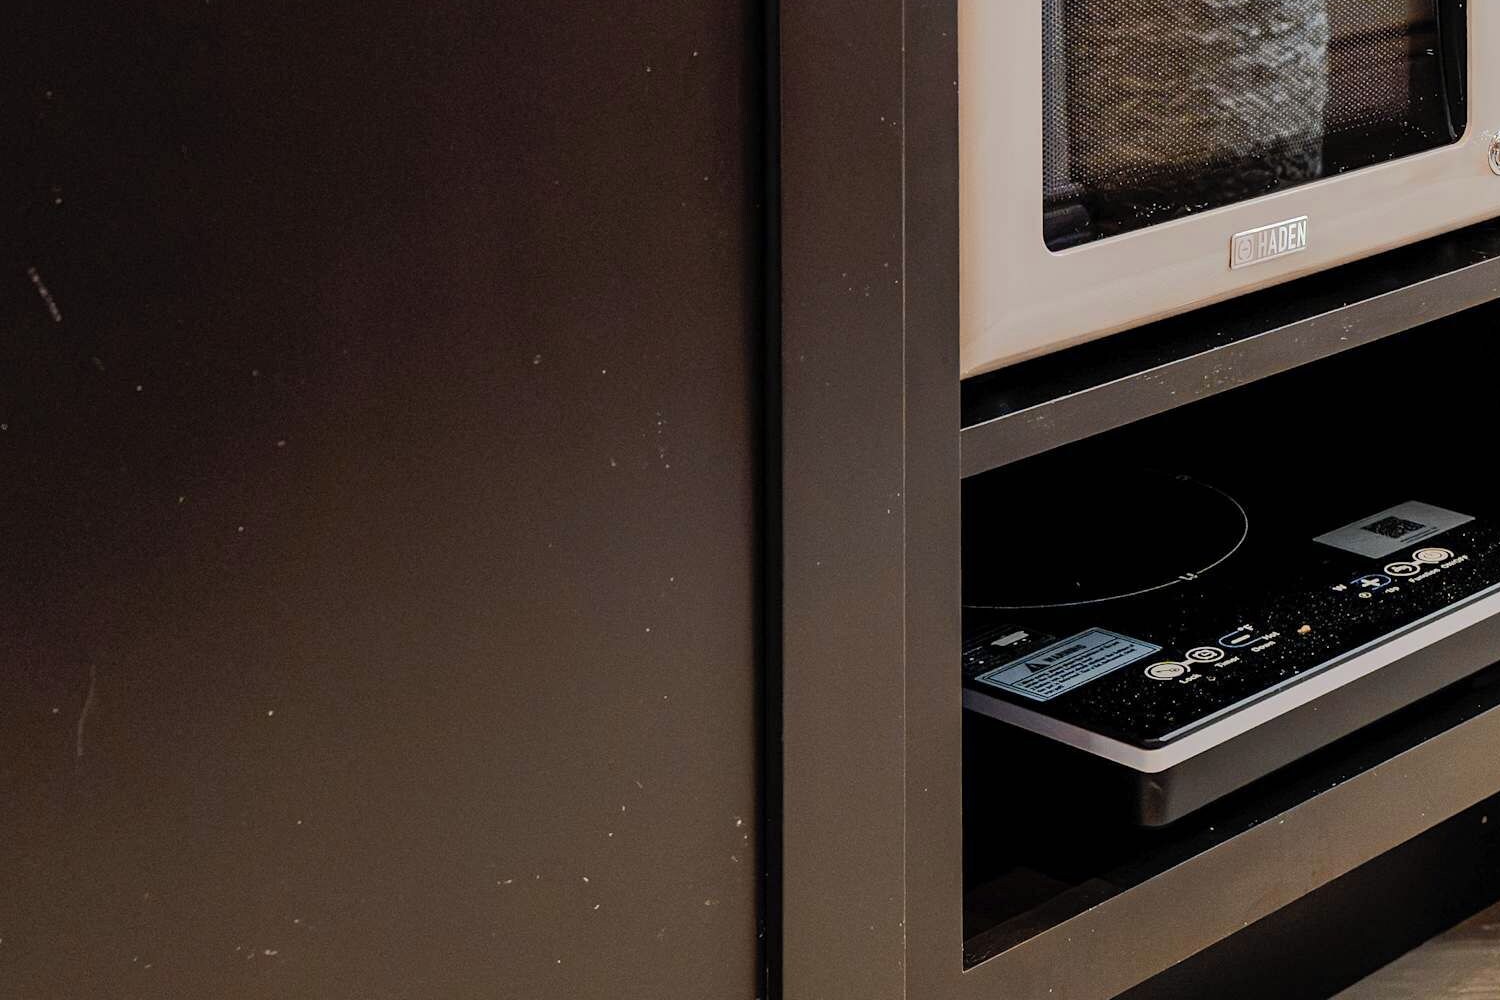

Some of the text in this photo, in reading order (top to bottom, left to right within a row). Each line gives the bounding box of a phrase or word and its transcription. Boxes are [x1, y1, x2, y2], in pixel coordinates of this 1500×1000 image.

[1257, 220, 1307, 258] HADEN
[1251, 641, 1276, 653] Down
[1214, 656, 1240, 668] Timer
[1179, 672, 1203, 684] Lock
